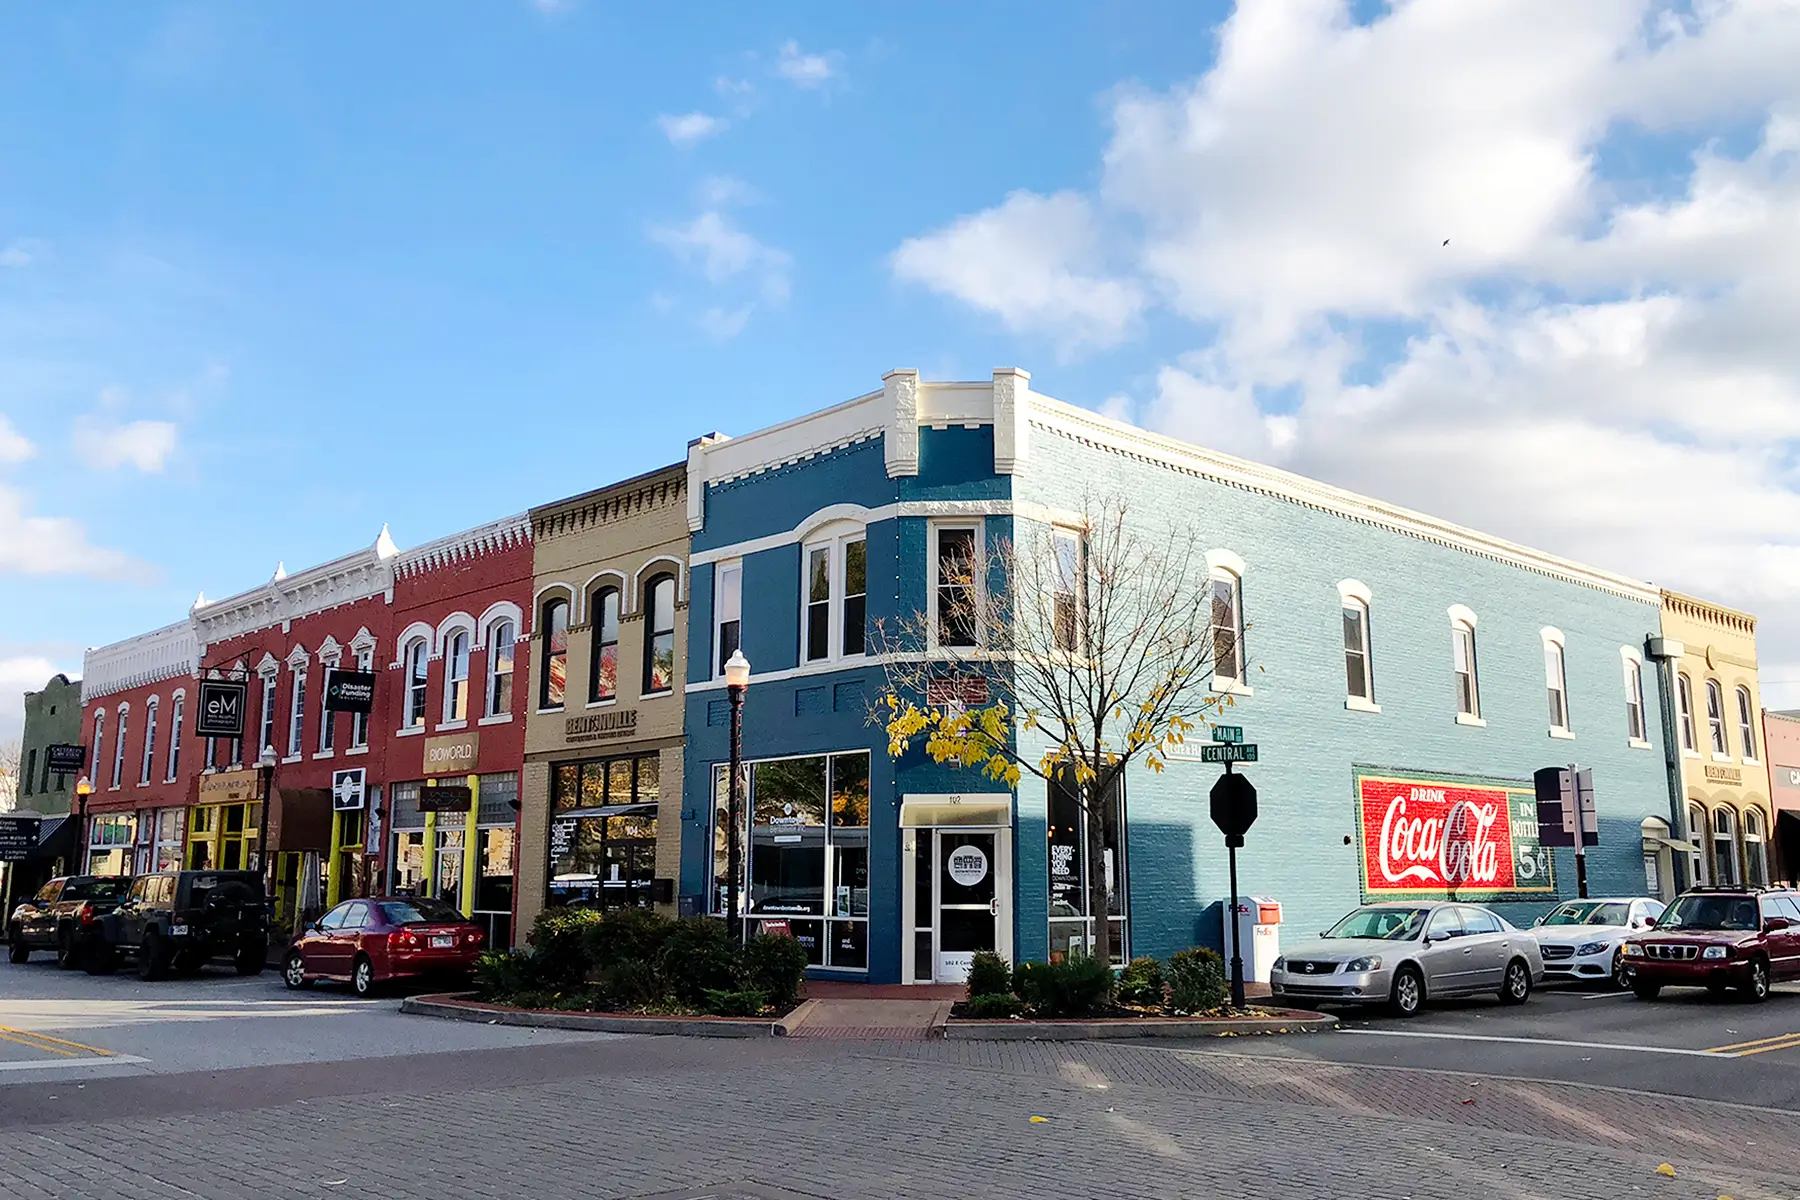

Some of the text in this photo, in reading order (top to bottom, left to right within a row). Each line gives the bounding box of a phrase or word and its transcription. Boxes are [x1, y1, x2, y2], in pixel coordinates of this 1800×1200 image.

[342, 683, 371, 691] Disaster
[341, 690, 371, 698] Funding
[208, 695, 237, 714] eM
[1217, 727, 1235, 741] MAIN
[430, 745, 472, 762] BIOWORLD
[1206, 747, 1245, 761] CENTRAL
[1246, 746, 1255, 754] AVE
[1246, 753, 1256, 761] 100
[1410, 787, 1446, 803] DRINK
[949, 796, 961, 804] 102
[1520, 803, 1534, 816] IN
[626, 826, 639, 836] 104
[1512, 820, 1539, 838] BOTTLE
[1379, 796, 1498, 882] Coca-Cola
[1052, 845, 1075, 854] EVERY-
[1052, 852, 1073, 861] THING
[1051, 859, 1067, 868] YOU
[1051, 867, 1070, 875] NEED
[1256, 927, 1273, 936] FedEx
